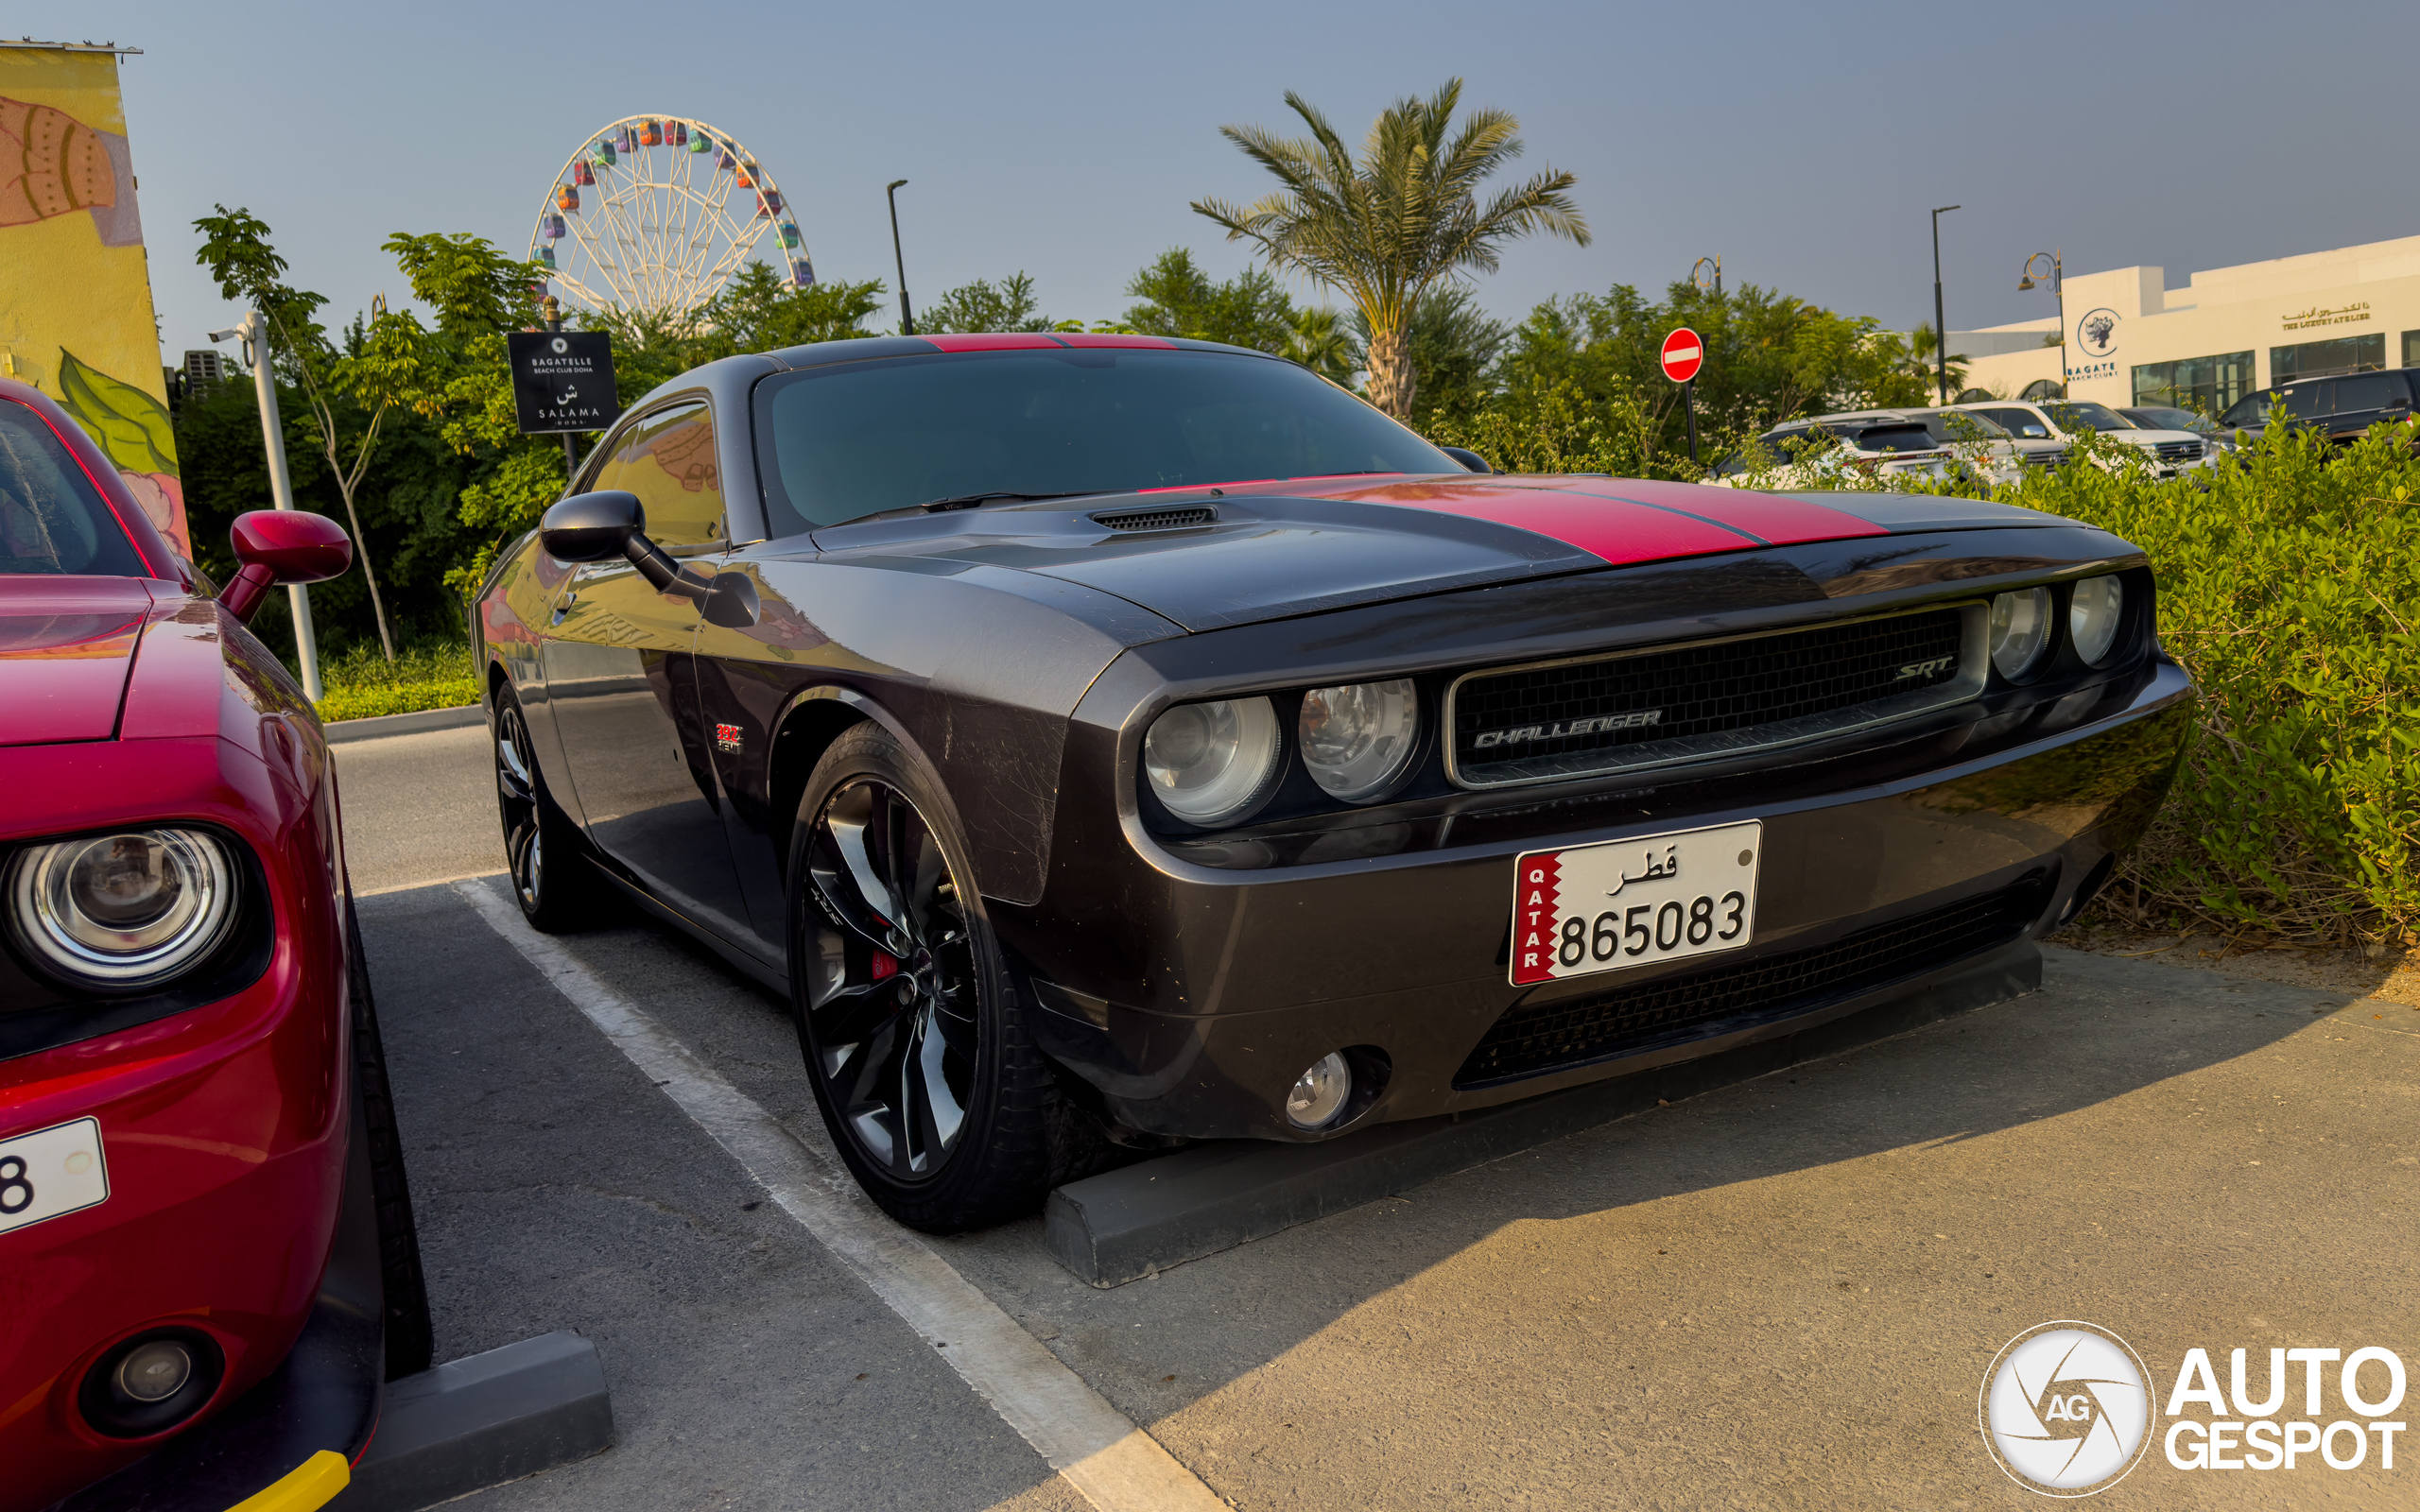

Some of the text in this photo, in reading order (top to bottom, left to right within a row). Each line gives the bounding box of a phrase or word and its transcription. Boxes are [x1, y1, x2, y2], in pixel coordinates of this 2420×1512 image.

[2282, 313, 2371, 331] THE LUXURY ATELIER
[531, 357, 592, 367] BAGATELLE
[539, 407, 599, 419] SALAMA
[1895, 656, 1954, 680] SRT
[717, 724, 739, 743] 392
[1474, 710, 1663, 748] CHALLENGER
[1603, 843, 1678, 897] قطر
[1524, 868, 1545, 968] QATAR
[1558, 890, 1745, 968] 865083
